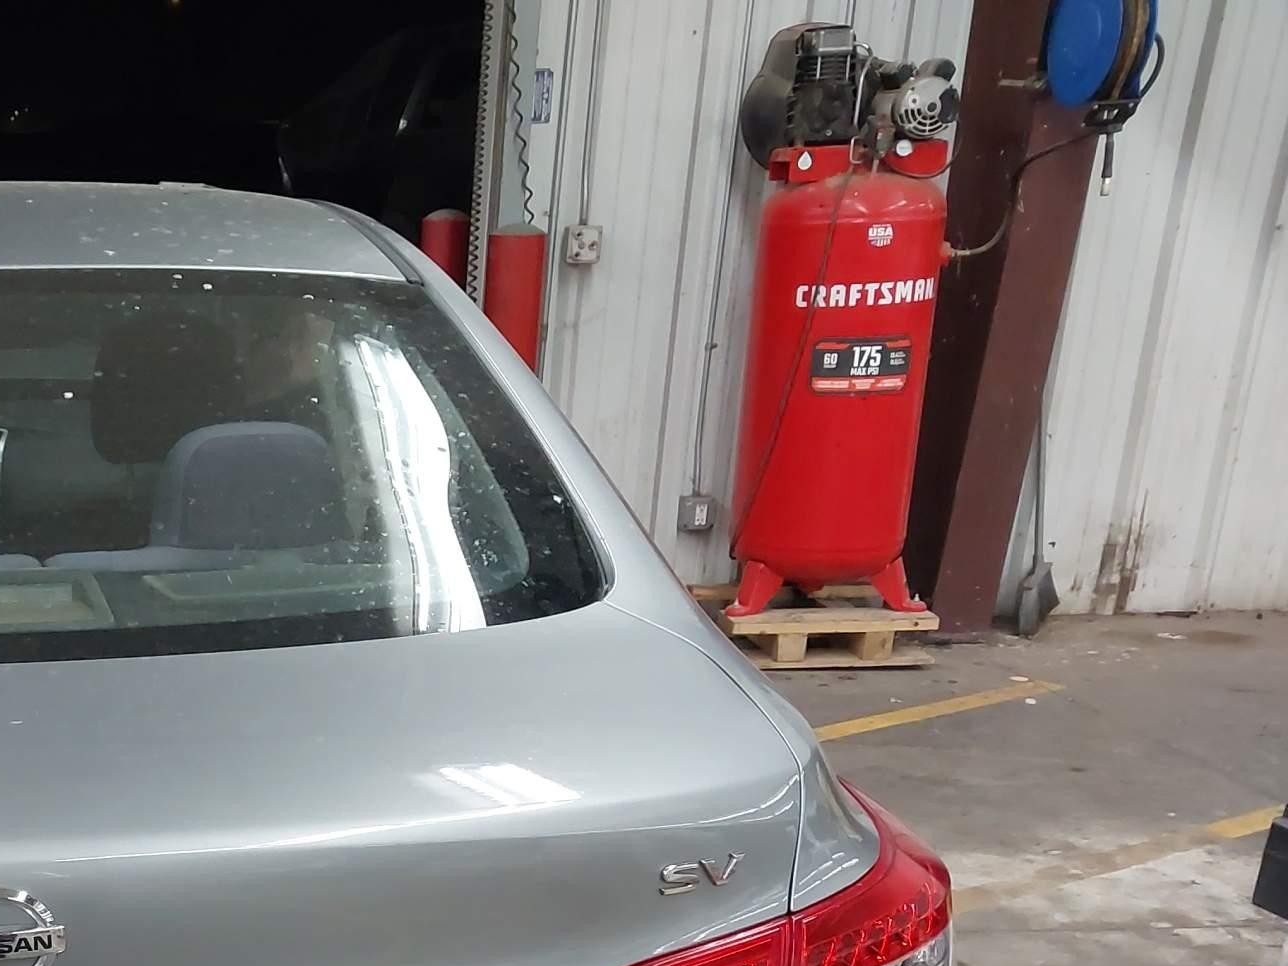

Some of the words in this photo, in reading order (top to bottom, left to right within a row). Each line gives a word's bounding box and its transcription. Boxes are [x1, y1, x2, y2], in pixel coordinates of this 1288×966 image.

[868, 227, 894, 238] USA
[795, 277, 935, 308] CRAFTSMAN
[823, 353, 839, 365] 60
[852, 345, 883, 368] 175
[850, 367, 867, 376] MAX
[867, 367, 880, 375] PSI
[658, 852, 746, 896] SV
